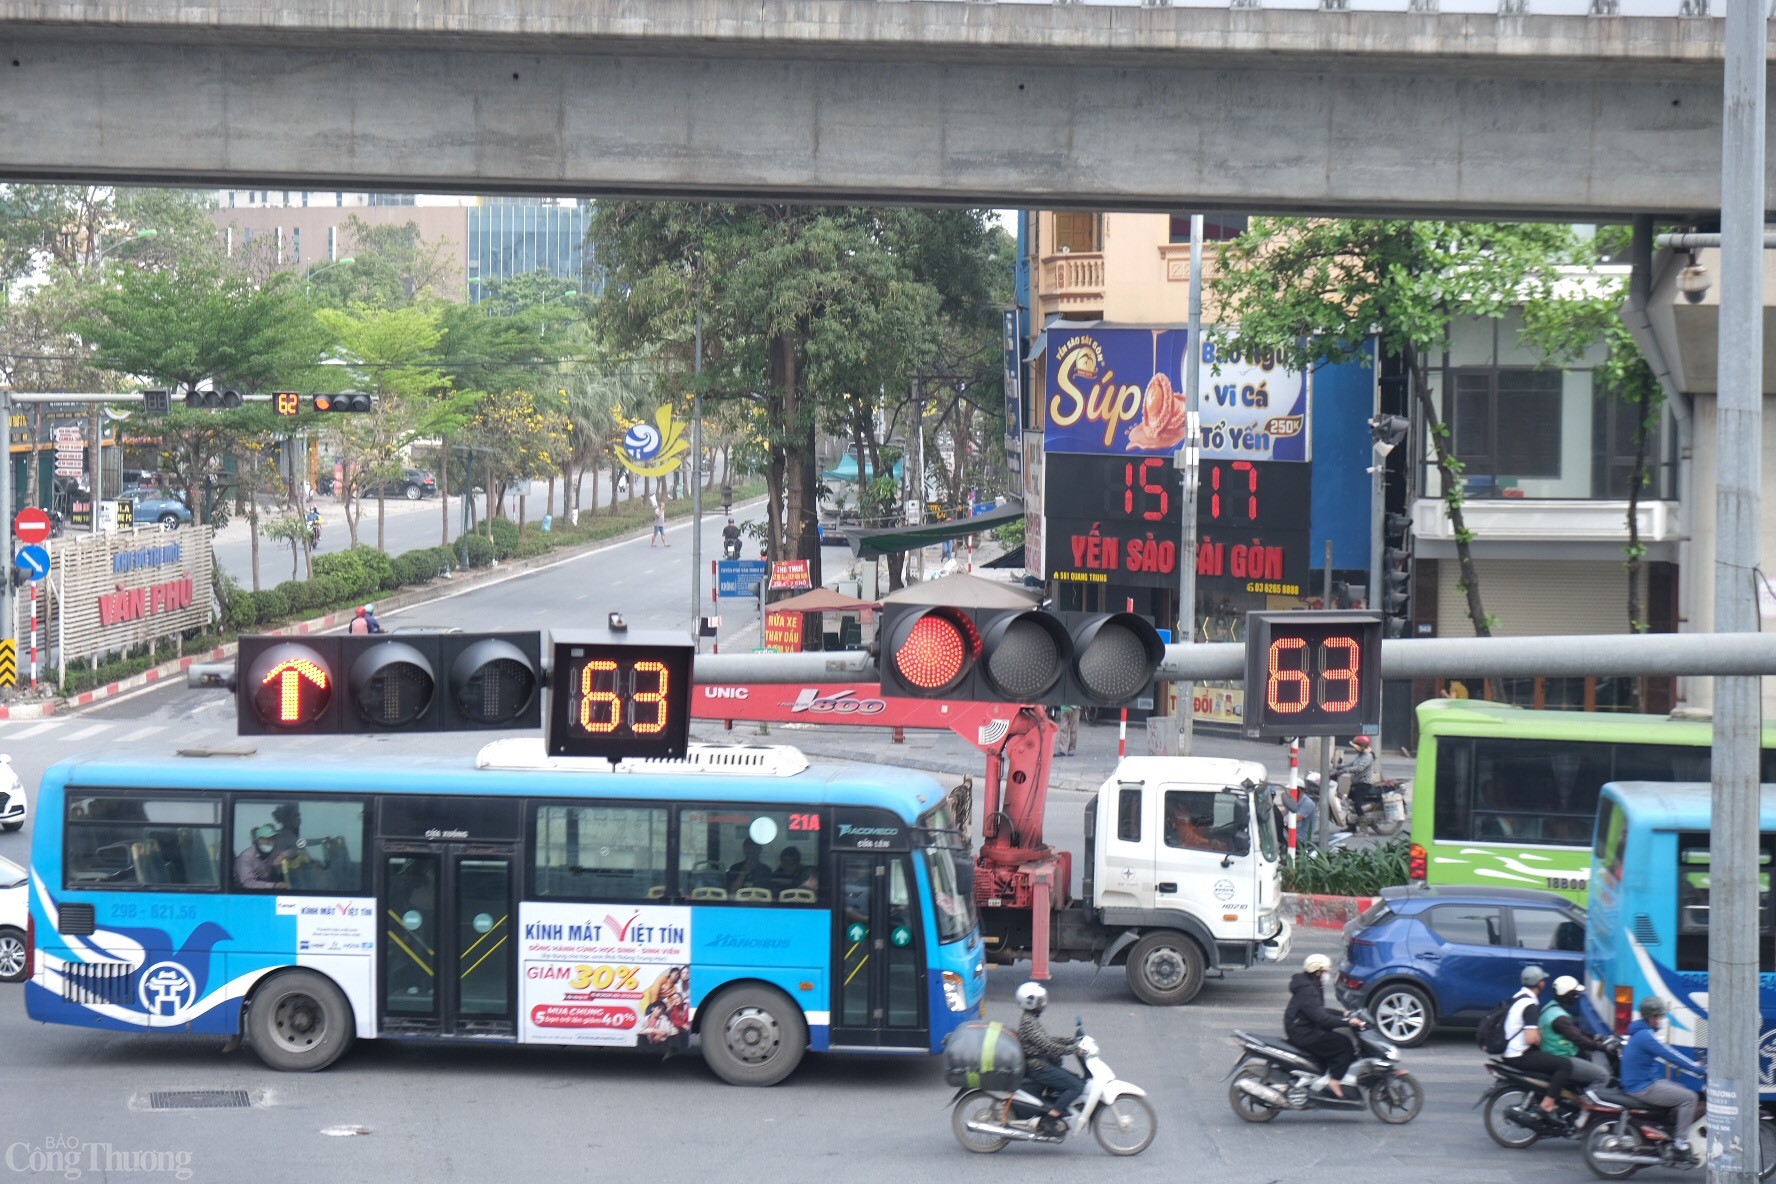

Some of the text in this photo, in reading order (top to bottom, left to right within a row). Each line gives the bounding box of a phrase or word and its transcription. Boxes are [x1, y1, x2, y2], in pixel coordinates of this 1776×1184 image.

[278, 393, 298, 414] 62
[1050, 346, 1142, 447] Súp
[1242, 380, 1269, 408] Cá
[1200, 420, 1270, 451] Tổ Yến
[1124, 457, 1257, 521] 15 17
[1071, 522, 1119, 570] YẾN
[1126, 532, 1176, 573] SÀO
[1231, 538, 1284, 580] GÒN
[1089, 573, 1107, 583] TRUNG
[768, 612, 797, 628] RỬA XE
[765, 630, 783, 642] THAY
[1268, 637, 1360, 713] 63
[581, 660, 669, 733] 63
[704, 687, 749, 700] UNIC
[1193, 689, 1213, 714] ĐỔI
[789, 813, 821, 831] 21A
[111, 903, 137, 919] 29B
[525, 920, 563, 941] KÍNH
[568, 920, 602, 942] MẮT
[659, 924, 684, 944] TÍN
[527, 964, 641, 991] GIẢM 30%
[534, 1011, 546, 1024] 5
[602, 1012, 635, 1027] 40%
[547, 1007, 604, 1016] MUA CHUNG
